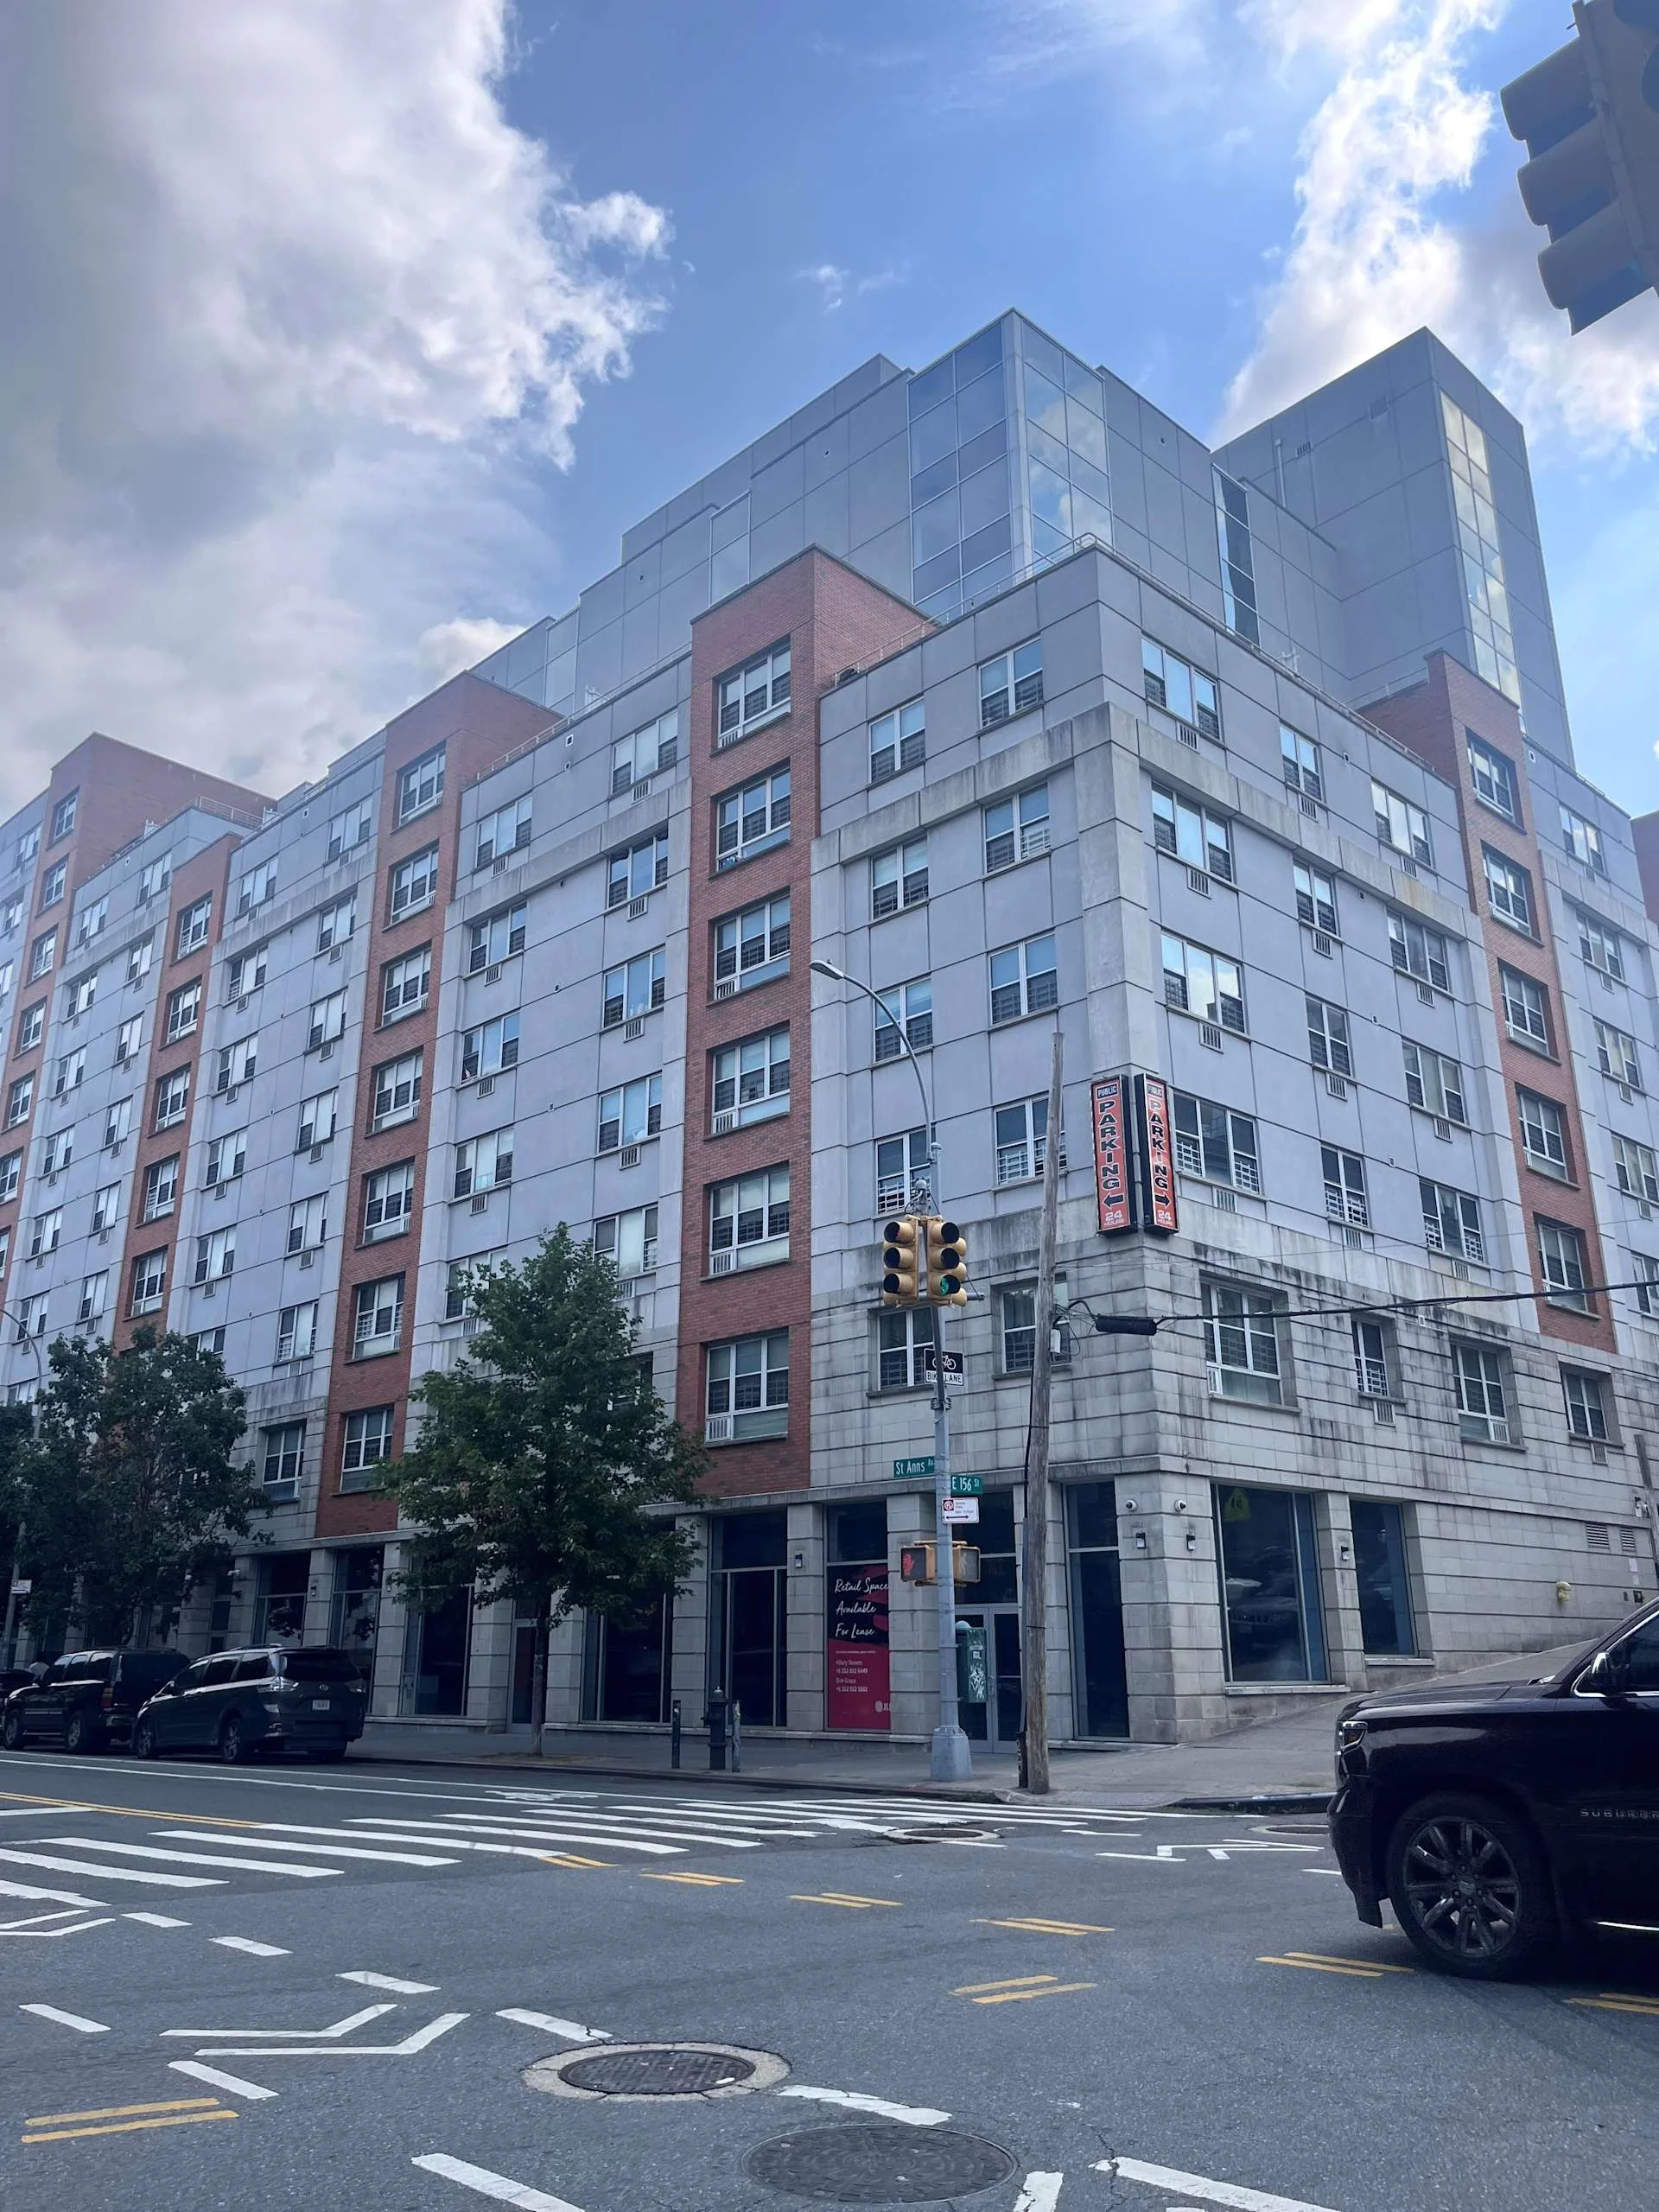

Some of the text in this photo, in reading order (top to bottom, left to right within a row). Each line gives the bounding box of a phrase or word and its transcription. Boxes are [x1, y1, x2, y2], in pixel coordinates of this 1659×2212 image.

[1098, 1085, 1116, 1097] PUBLIC
[1098, 1099, 1121, 1192] PARKING
[1148, 1098, 1169, 1192] PARKING
[1105, 1210, 1122, 1221] 24
[1158, 1210, 1172, 1221] 24
[944, 1373, 962, 1383] LANE
[895, 1461, 904, 1475] St
[906, 1460, 925, 1474] Anns
[952, 1476, 957, 1490] E
[960, 1478, 972, 1491] 156
[835, 1577, 891, 1594] Retail Space
[836, 1600, 877, 1616] Available
[836, 1622, 875, 1638] For Lease
